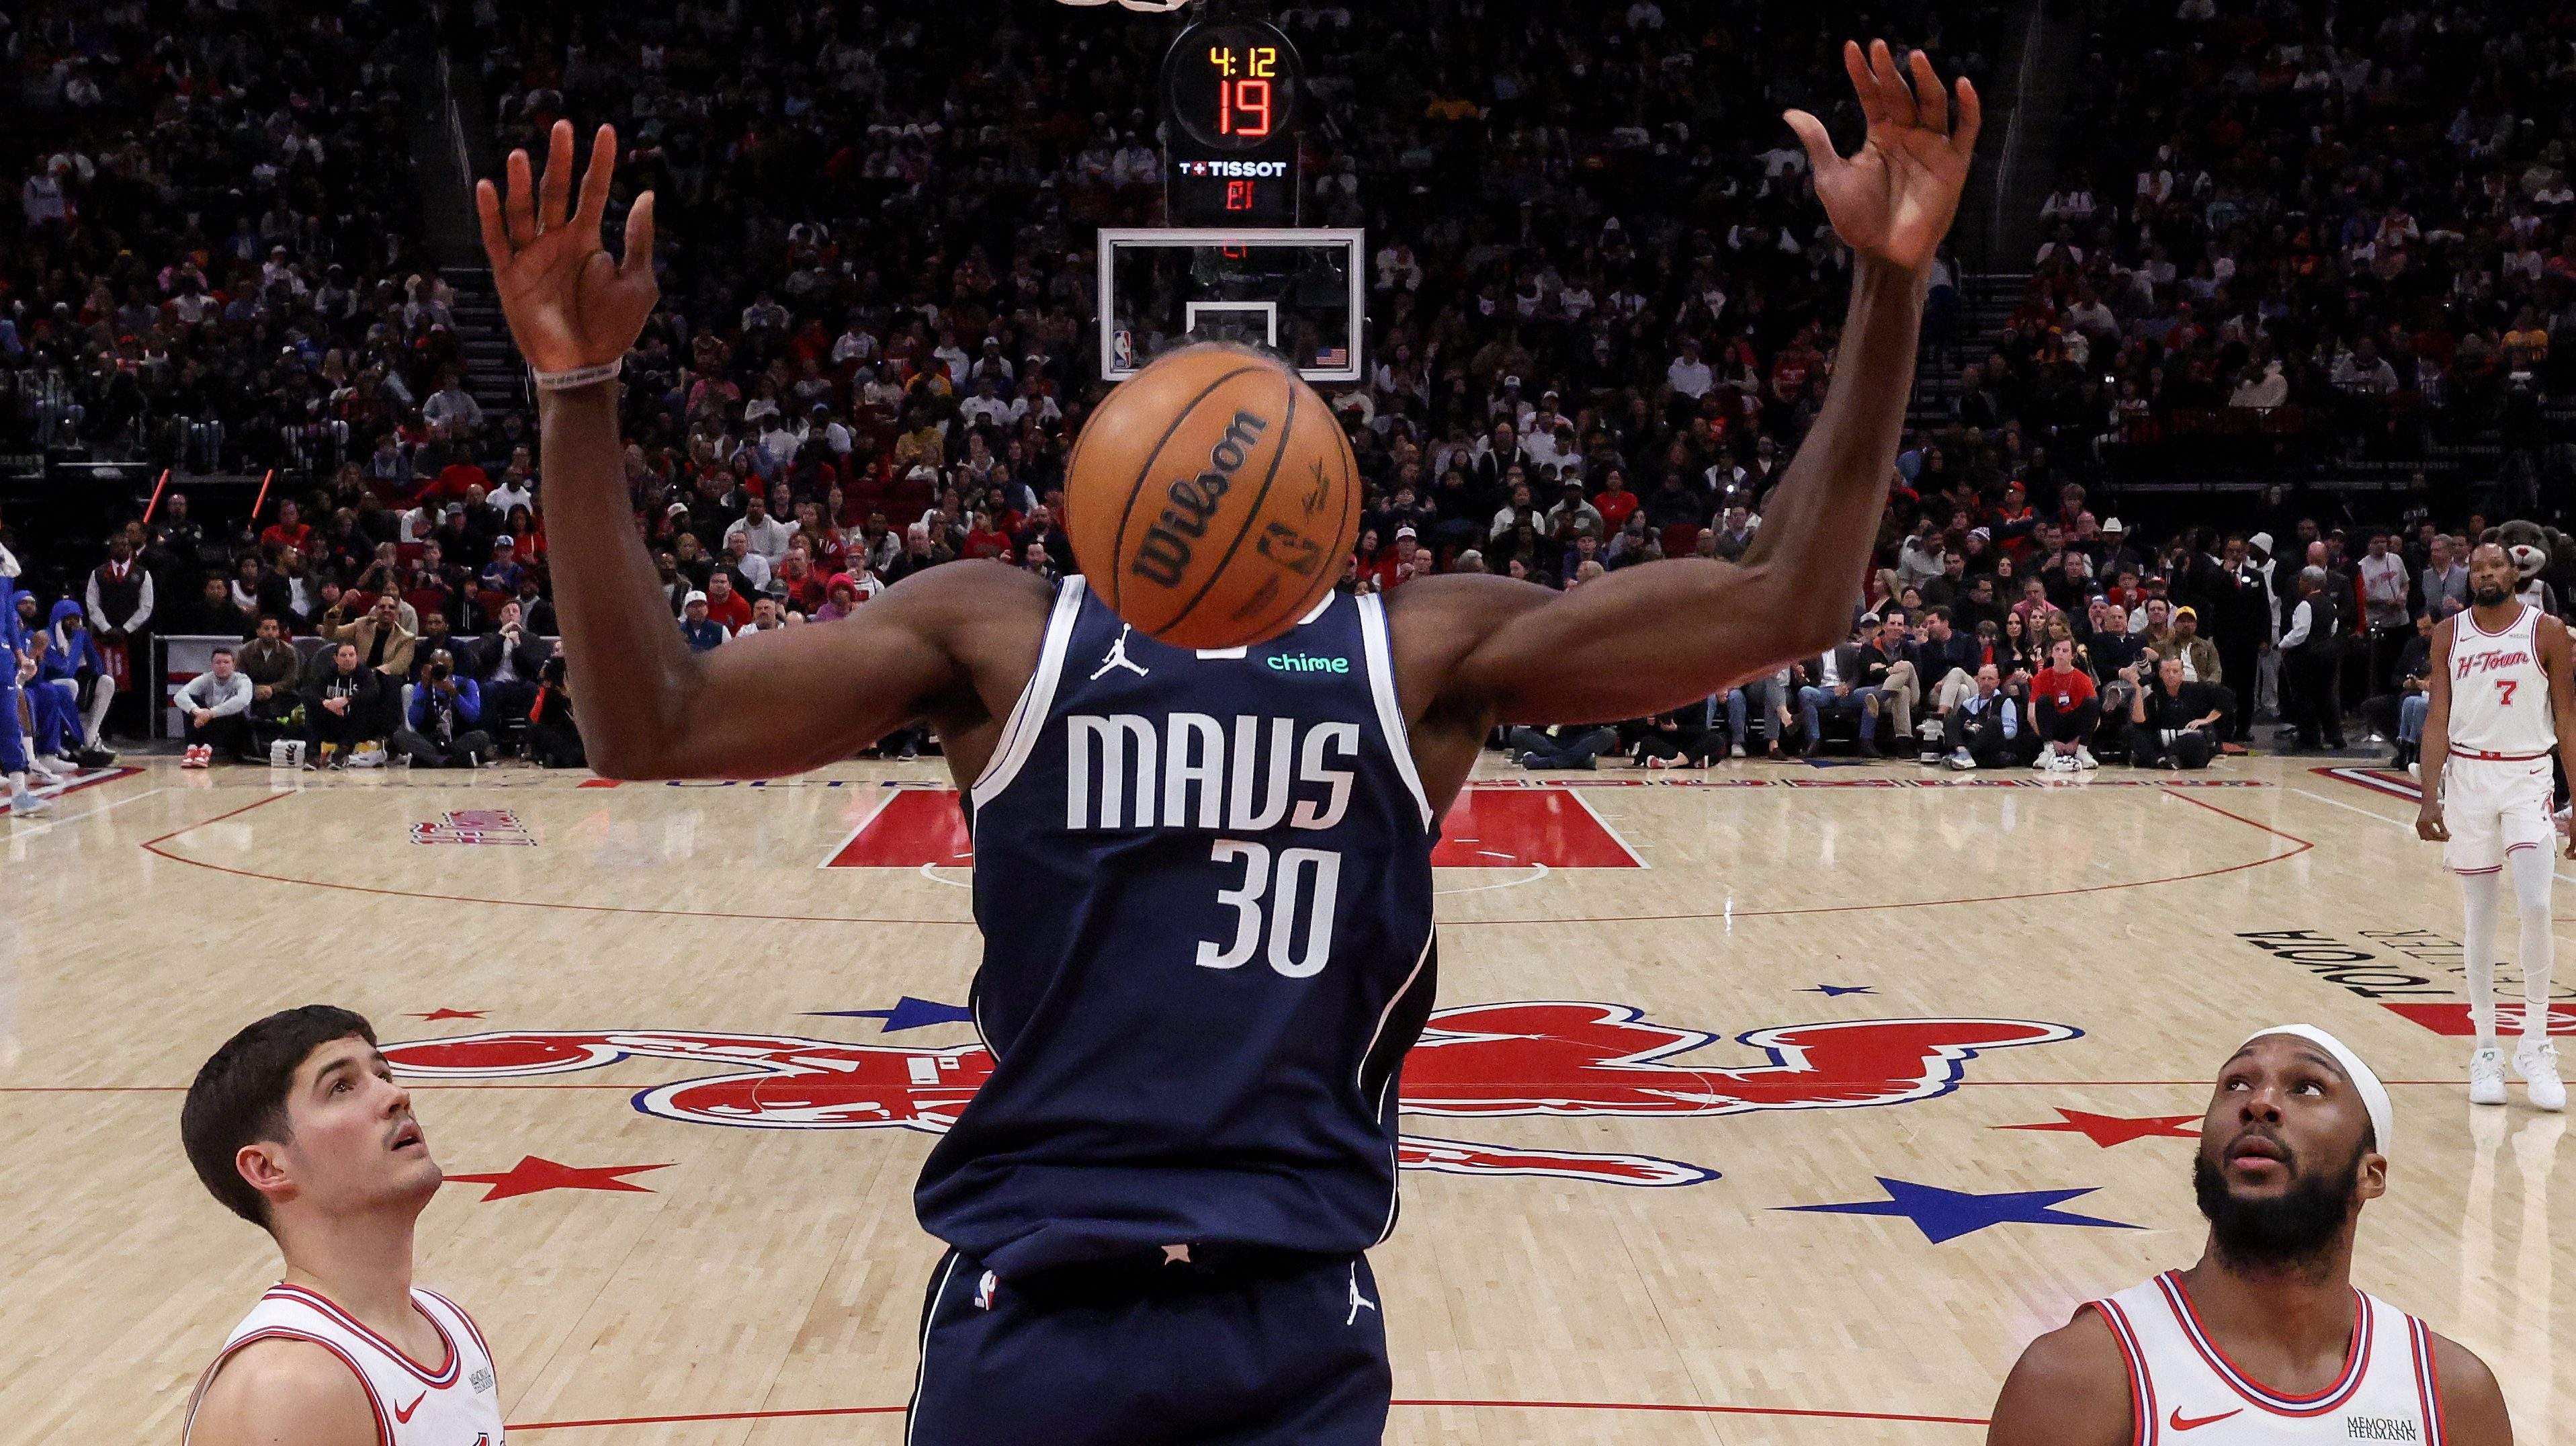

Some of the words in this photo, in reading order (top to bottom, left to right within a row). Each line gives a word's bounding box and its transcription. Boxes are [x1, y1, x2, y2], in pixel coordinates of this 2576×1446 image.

[1211, 47, 1276, 77] 4:12
[1221, 80, 1269, 135] 19
[1208, 161, 1287, 177] TISSOT
[1131, 408, 1269, 588] Wilson
[1267, 652, 1349, 673] chime
[2456, 648, 2530, 681] H-Town
[2495, 679, 2519, 708] 7
[1067, 712, 1360, 830] MAVS
[1196, 839, 1342, 978] 30
[2233, 930, 2455, 997] TOYOTA
[2348, 1416, 2416, 1431] MEMORIAL
[2348, 1426, 2416, 1441] HERMANN
